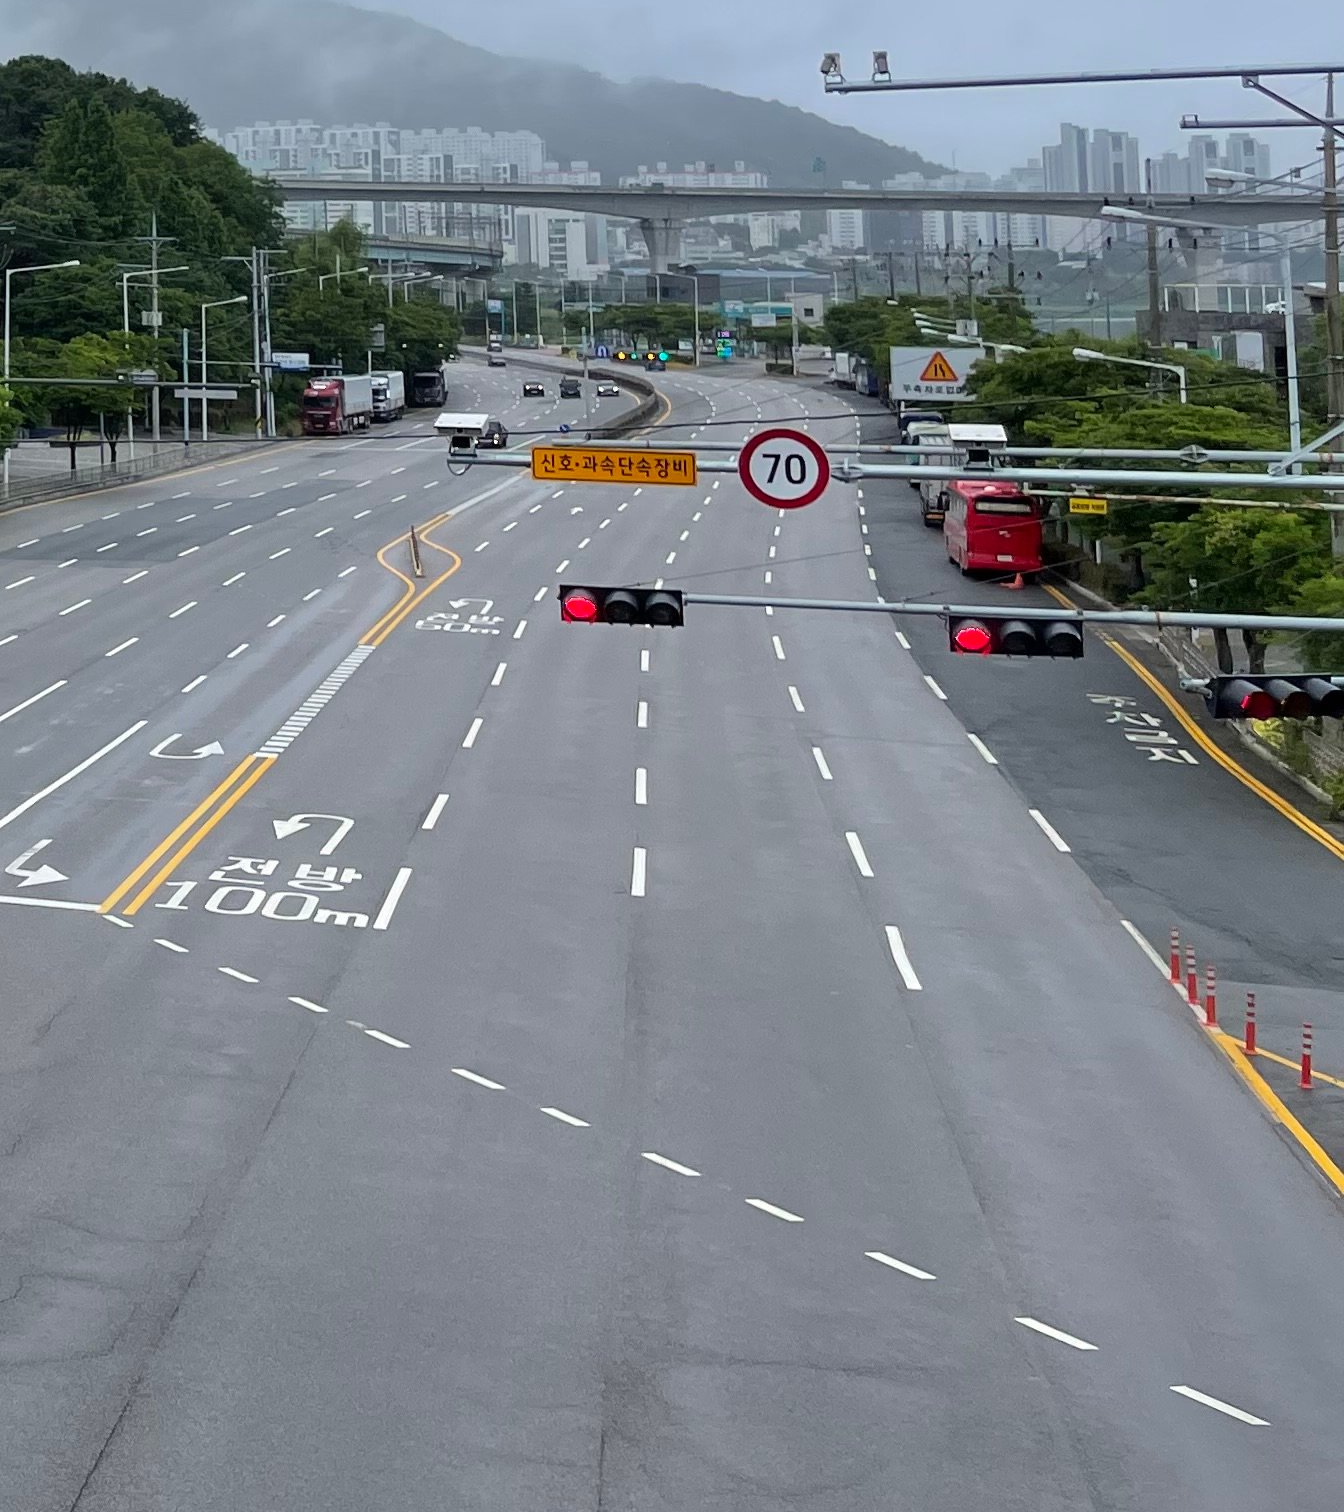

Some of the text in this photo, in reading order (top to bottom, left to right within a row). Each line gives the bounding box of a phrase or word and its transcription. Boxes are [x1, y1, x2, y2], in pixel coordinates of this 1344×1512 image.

[540, 452, 689, 478] 신호·과속단속장비
[762, 453, 807, 486] 70
[1086, 693, 1200, 765] 주차금지
[209, 856, 363, 892] 전방
[154, 880, 370, 928] 100m
